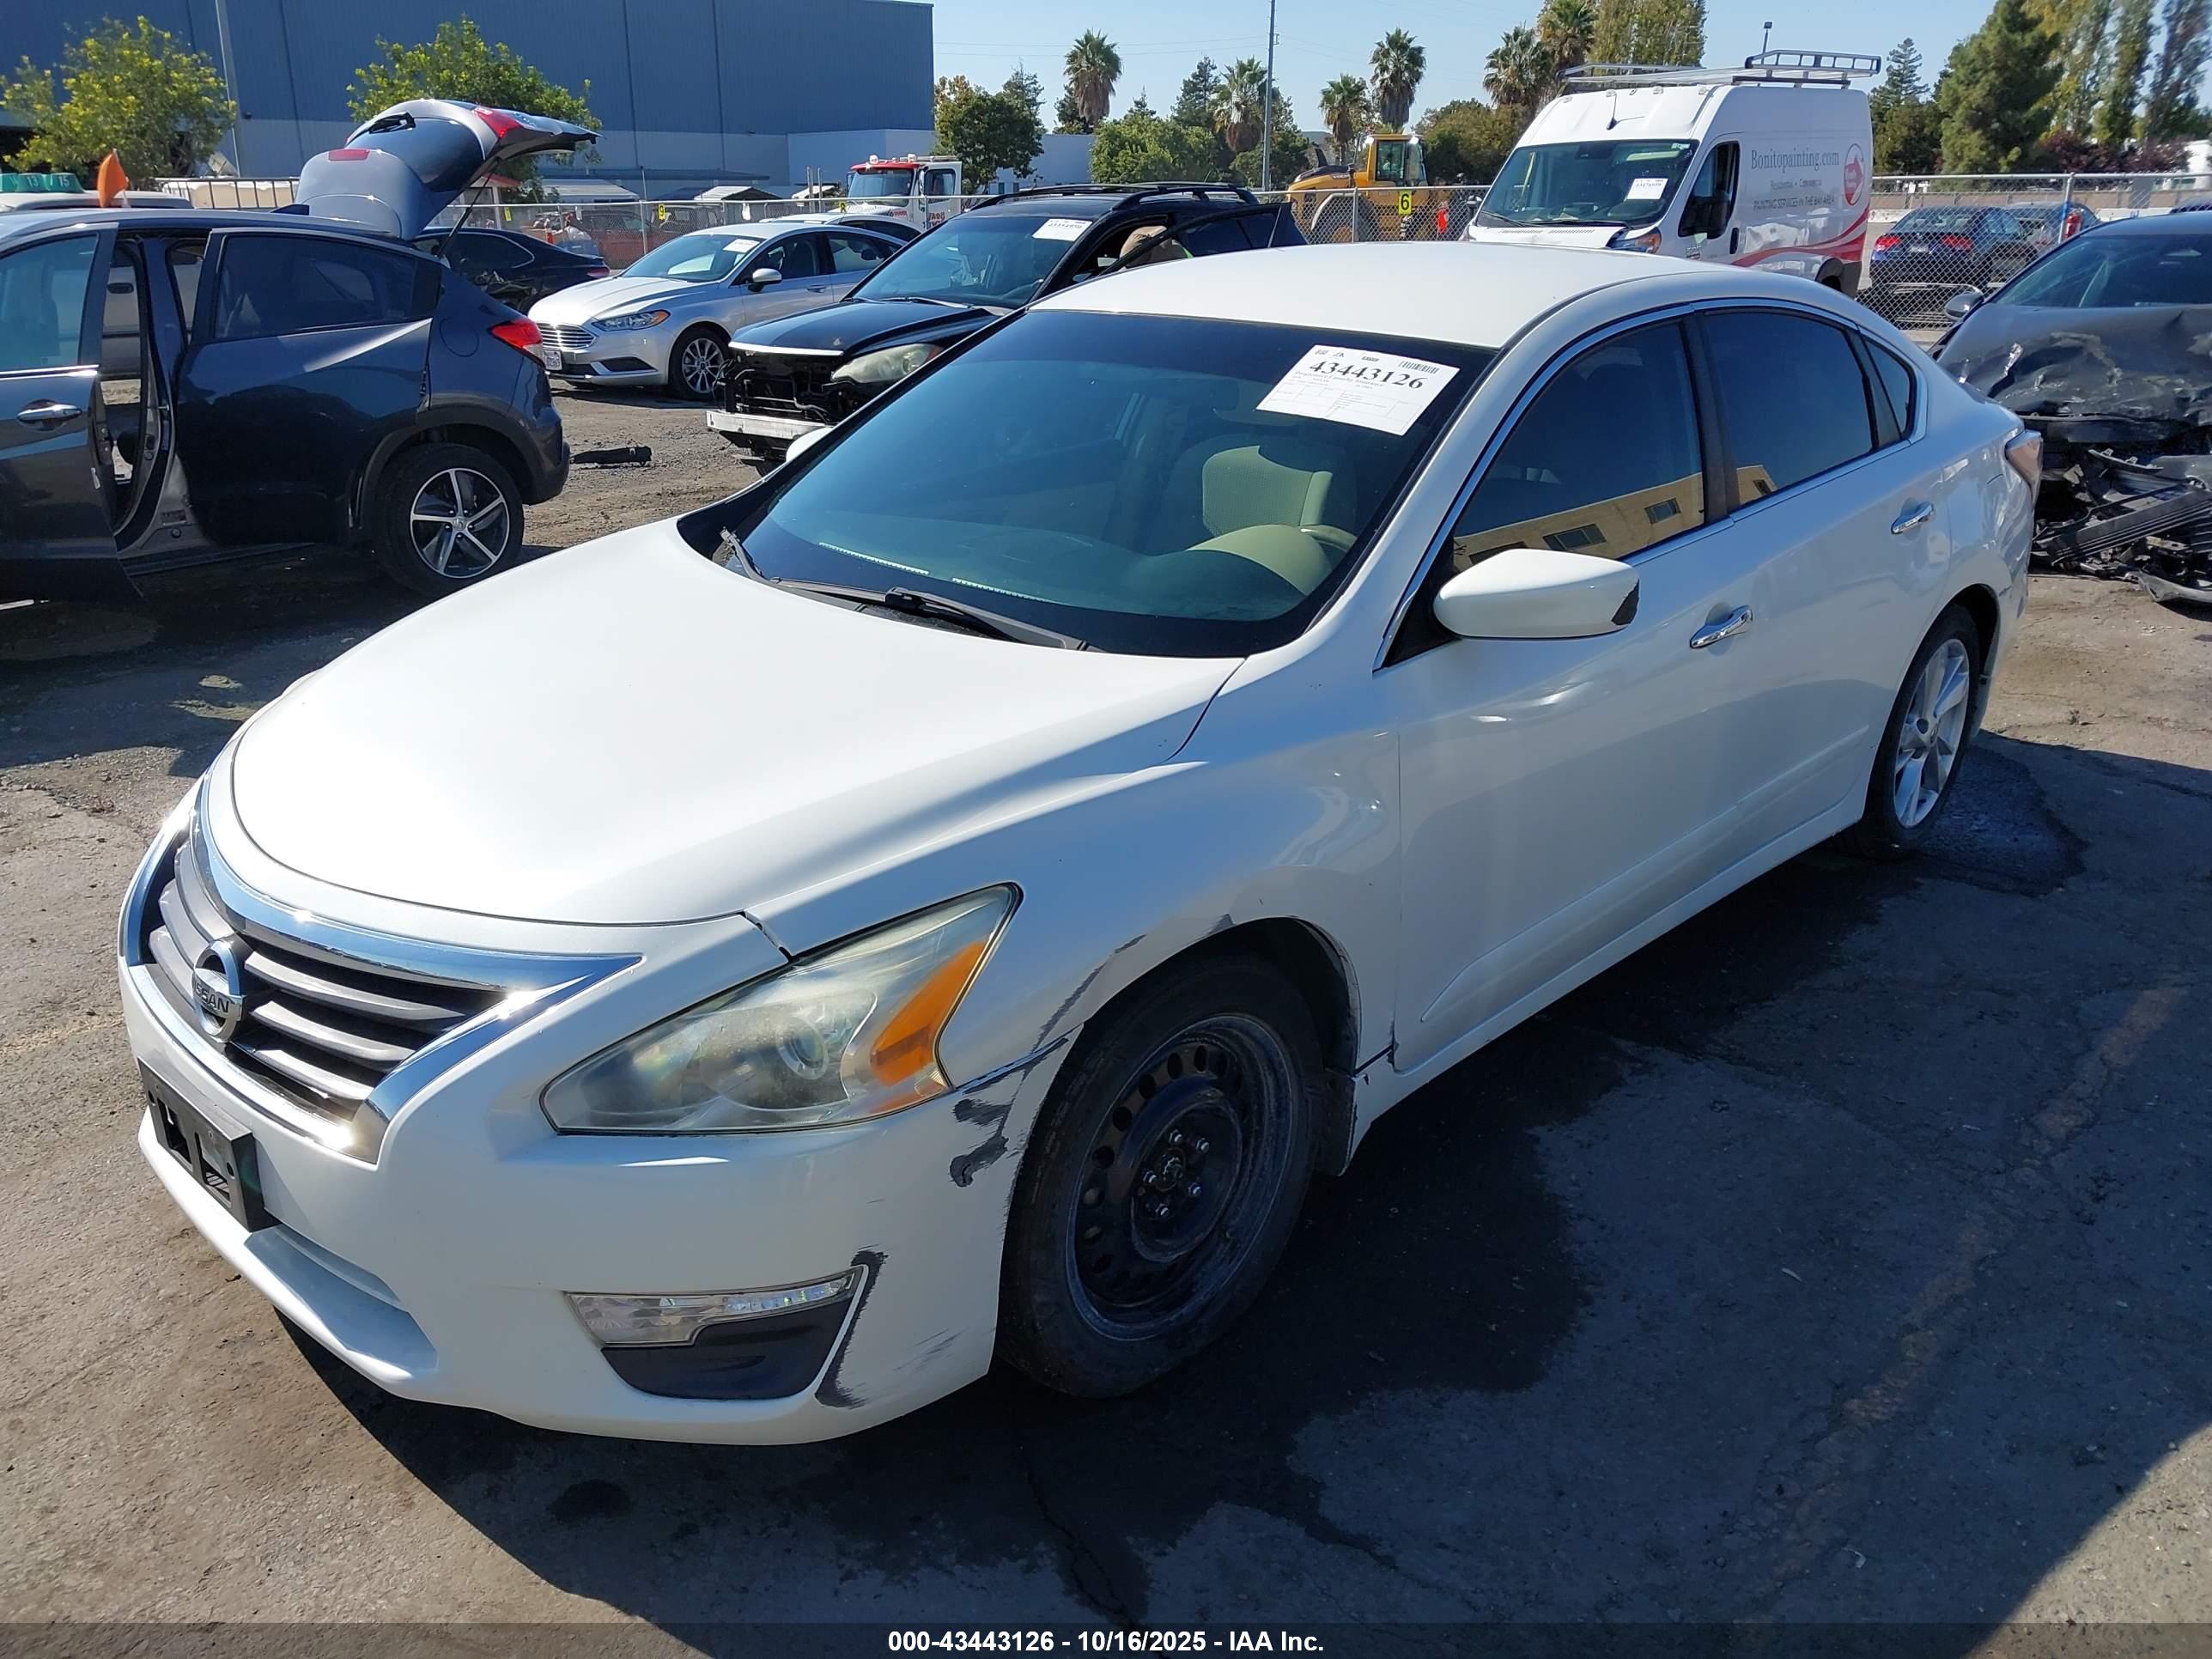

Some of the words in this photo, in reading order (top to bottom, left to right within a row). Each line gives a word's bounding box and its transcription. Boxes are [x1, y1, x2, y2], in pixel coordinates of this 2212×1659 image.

[1751, 147, 1839, 173] Bonitopainting.com
[27, 176, 39, 187] 13
[58, 176, 70, 187] 15
[1401, 193, 1410, 211] 6
[1309, 361, 1428, 390] 43443126
